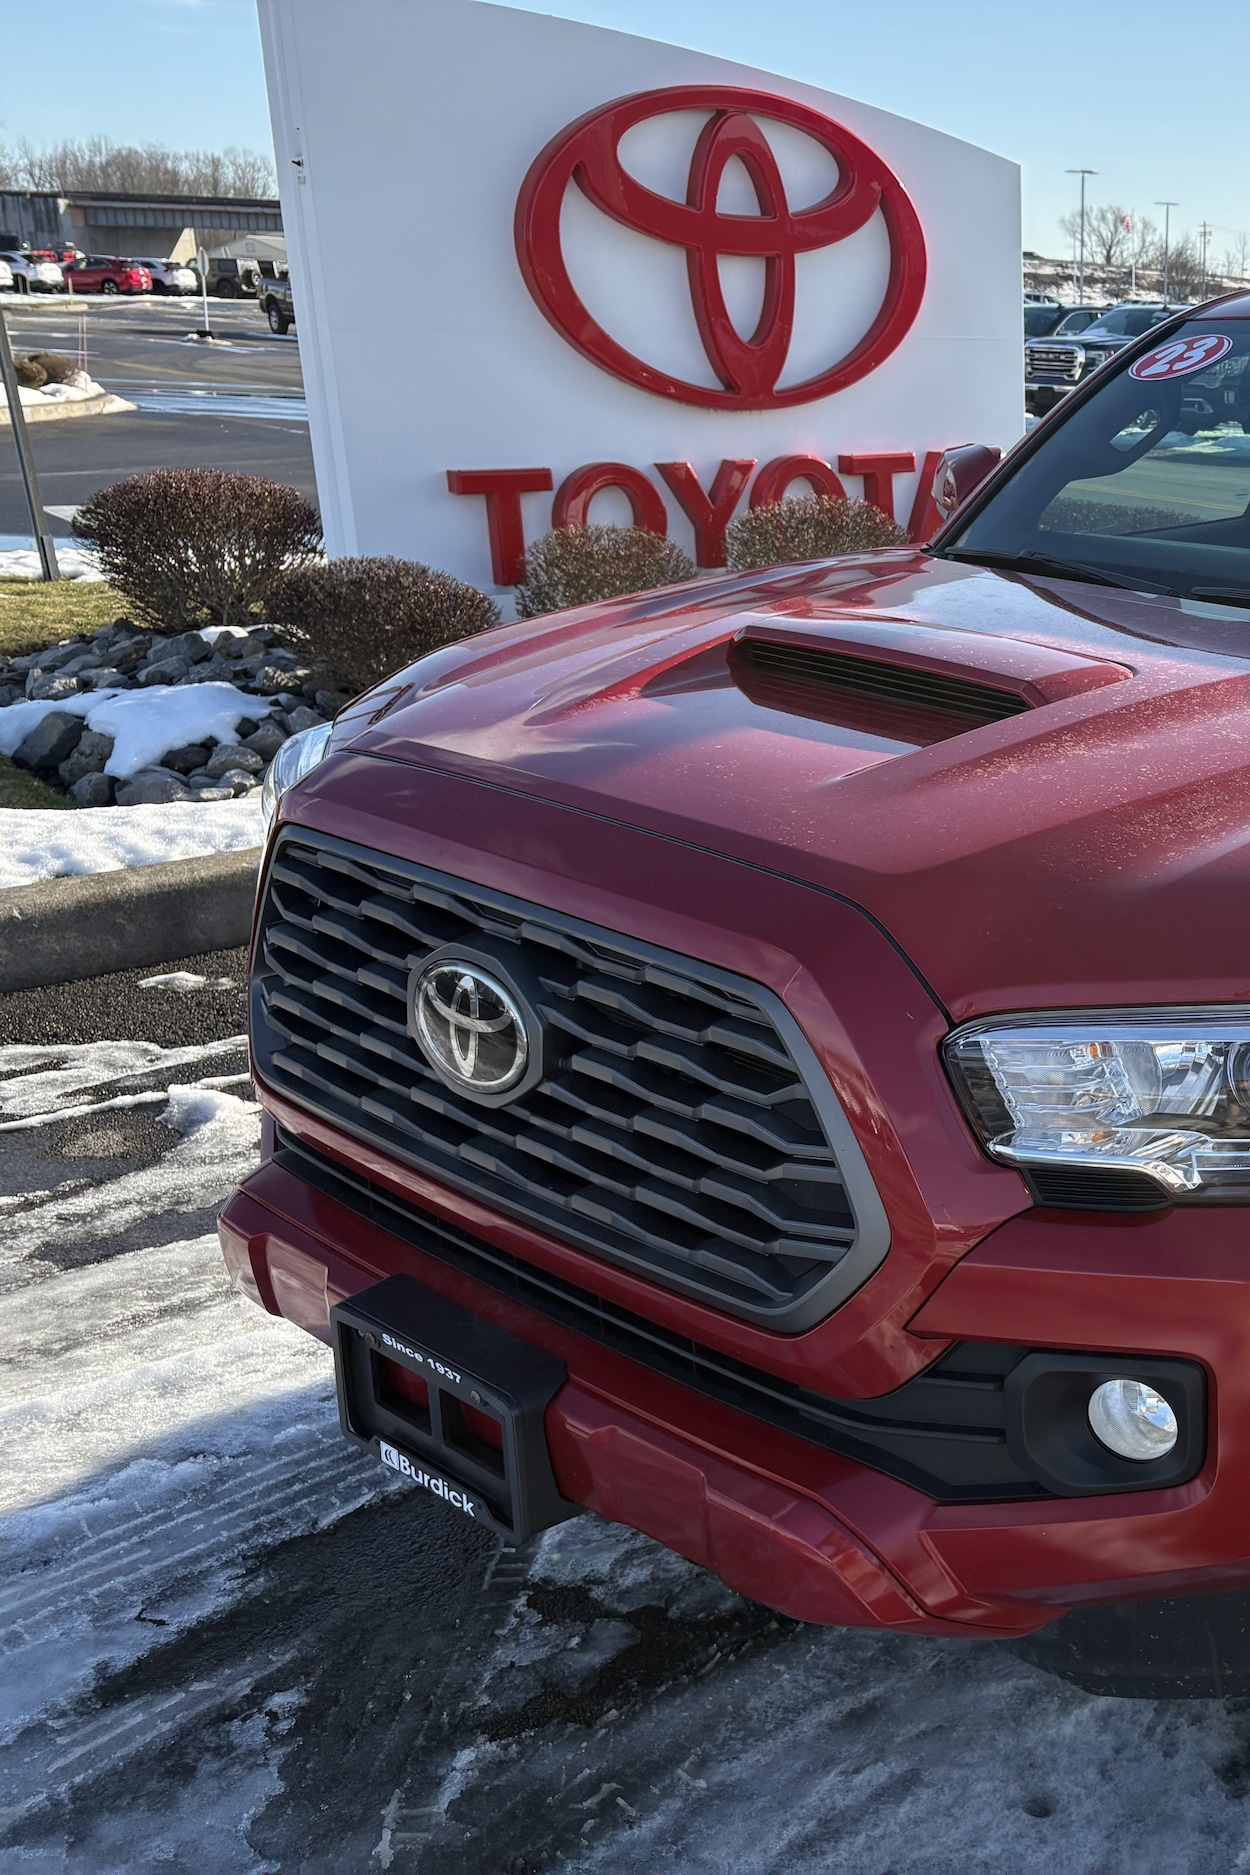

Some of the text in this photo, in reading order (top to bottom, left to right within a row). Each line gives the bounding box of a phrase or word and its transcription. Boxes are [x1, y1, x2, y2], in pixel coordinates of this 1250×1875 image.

[1140, 337, 1218, 376] 23
[381, 1332, 462, 1384] Since 1937
[400, 1458, 475, 1517] Burdick
